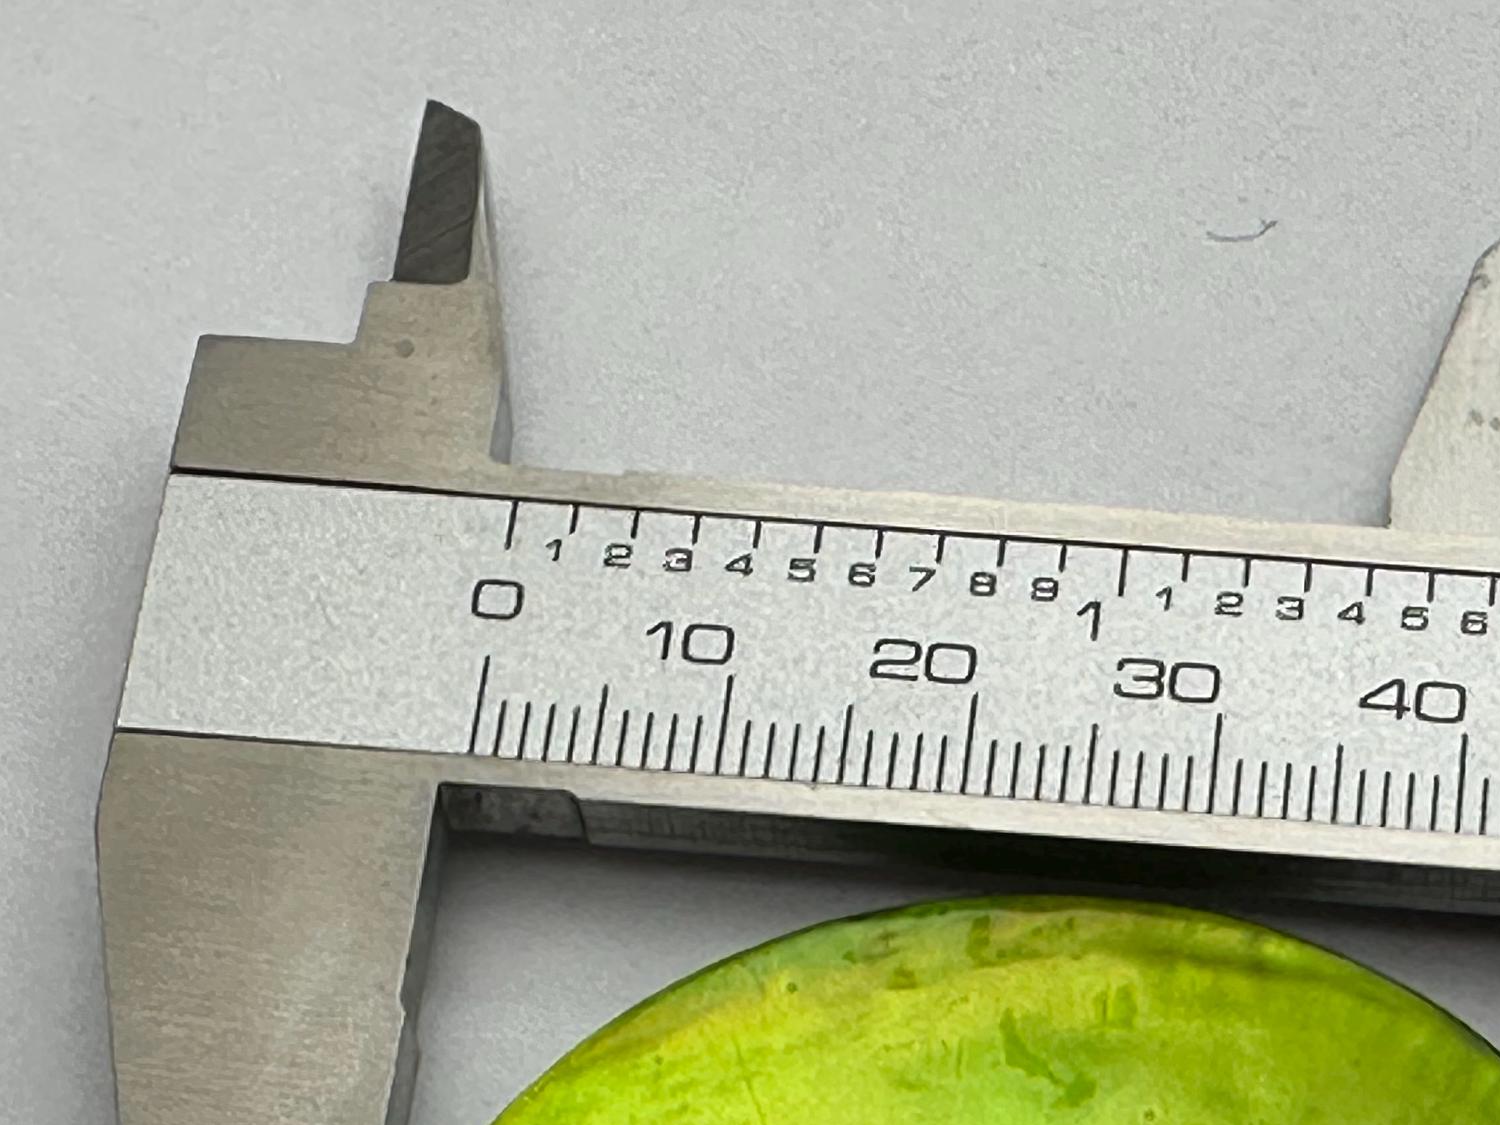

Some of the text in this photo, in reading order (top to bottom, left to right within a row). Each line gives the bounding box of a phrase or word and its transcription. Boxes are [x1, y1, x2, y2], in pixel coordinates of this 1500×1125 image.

[471, 578, 525, 620] 0
[545, 538, 563, 562] 1
[603, 542, 634, 568] 2
[662, 547, 694, 573] 3
[725, 552, 754, 577] 4
[788, 557, 817, 582] 5
[848, 562, 877, 587] 6
[909, 566, 936, 592] 7
[969, 571, 998, 597] 8
[1031, 576, 1060, 602] 9
[1076, 600, 1102, 641] 1
[1155, 586, 1173, 611] 1
[1214, 591, 1244, 617] 2
[1275, 596, 1305, 620] 3
[1337, 601, 1366, 625] 4
[1400, 606, 1429, 631] 5
[1461, 610, 1488, 634] 6
[646, 620, 736, 665] 10
[869, 638, 978, 684] 20
[1113, 657, 1221, 703] 30
[1359, 678, 1467, 724] 40
